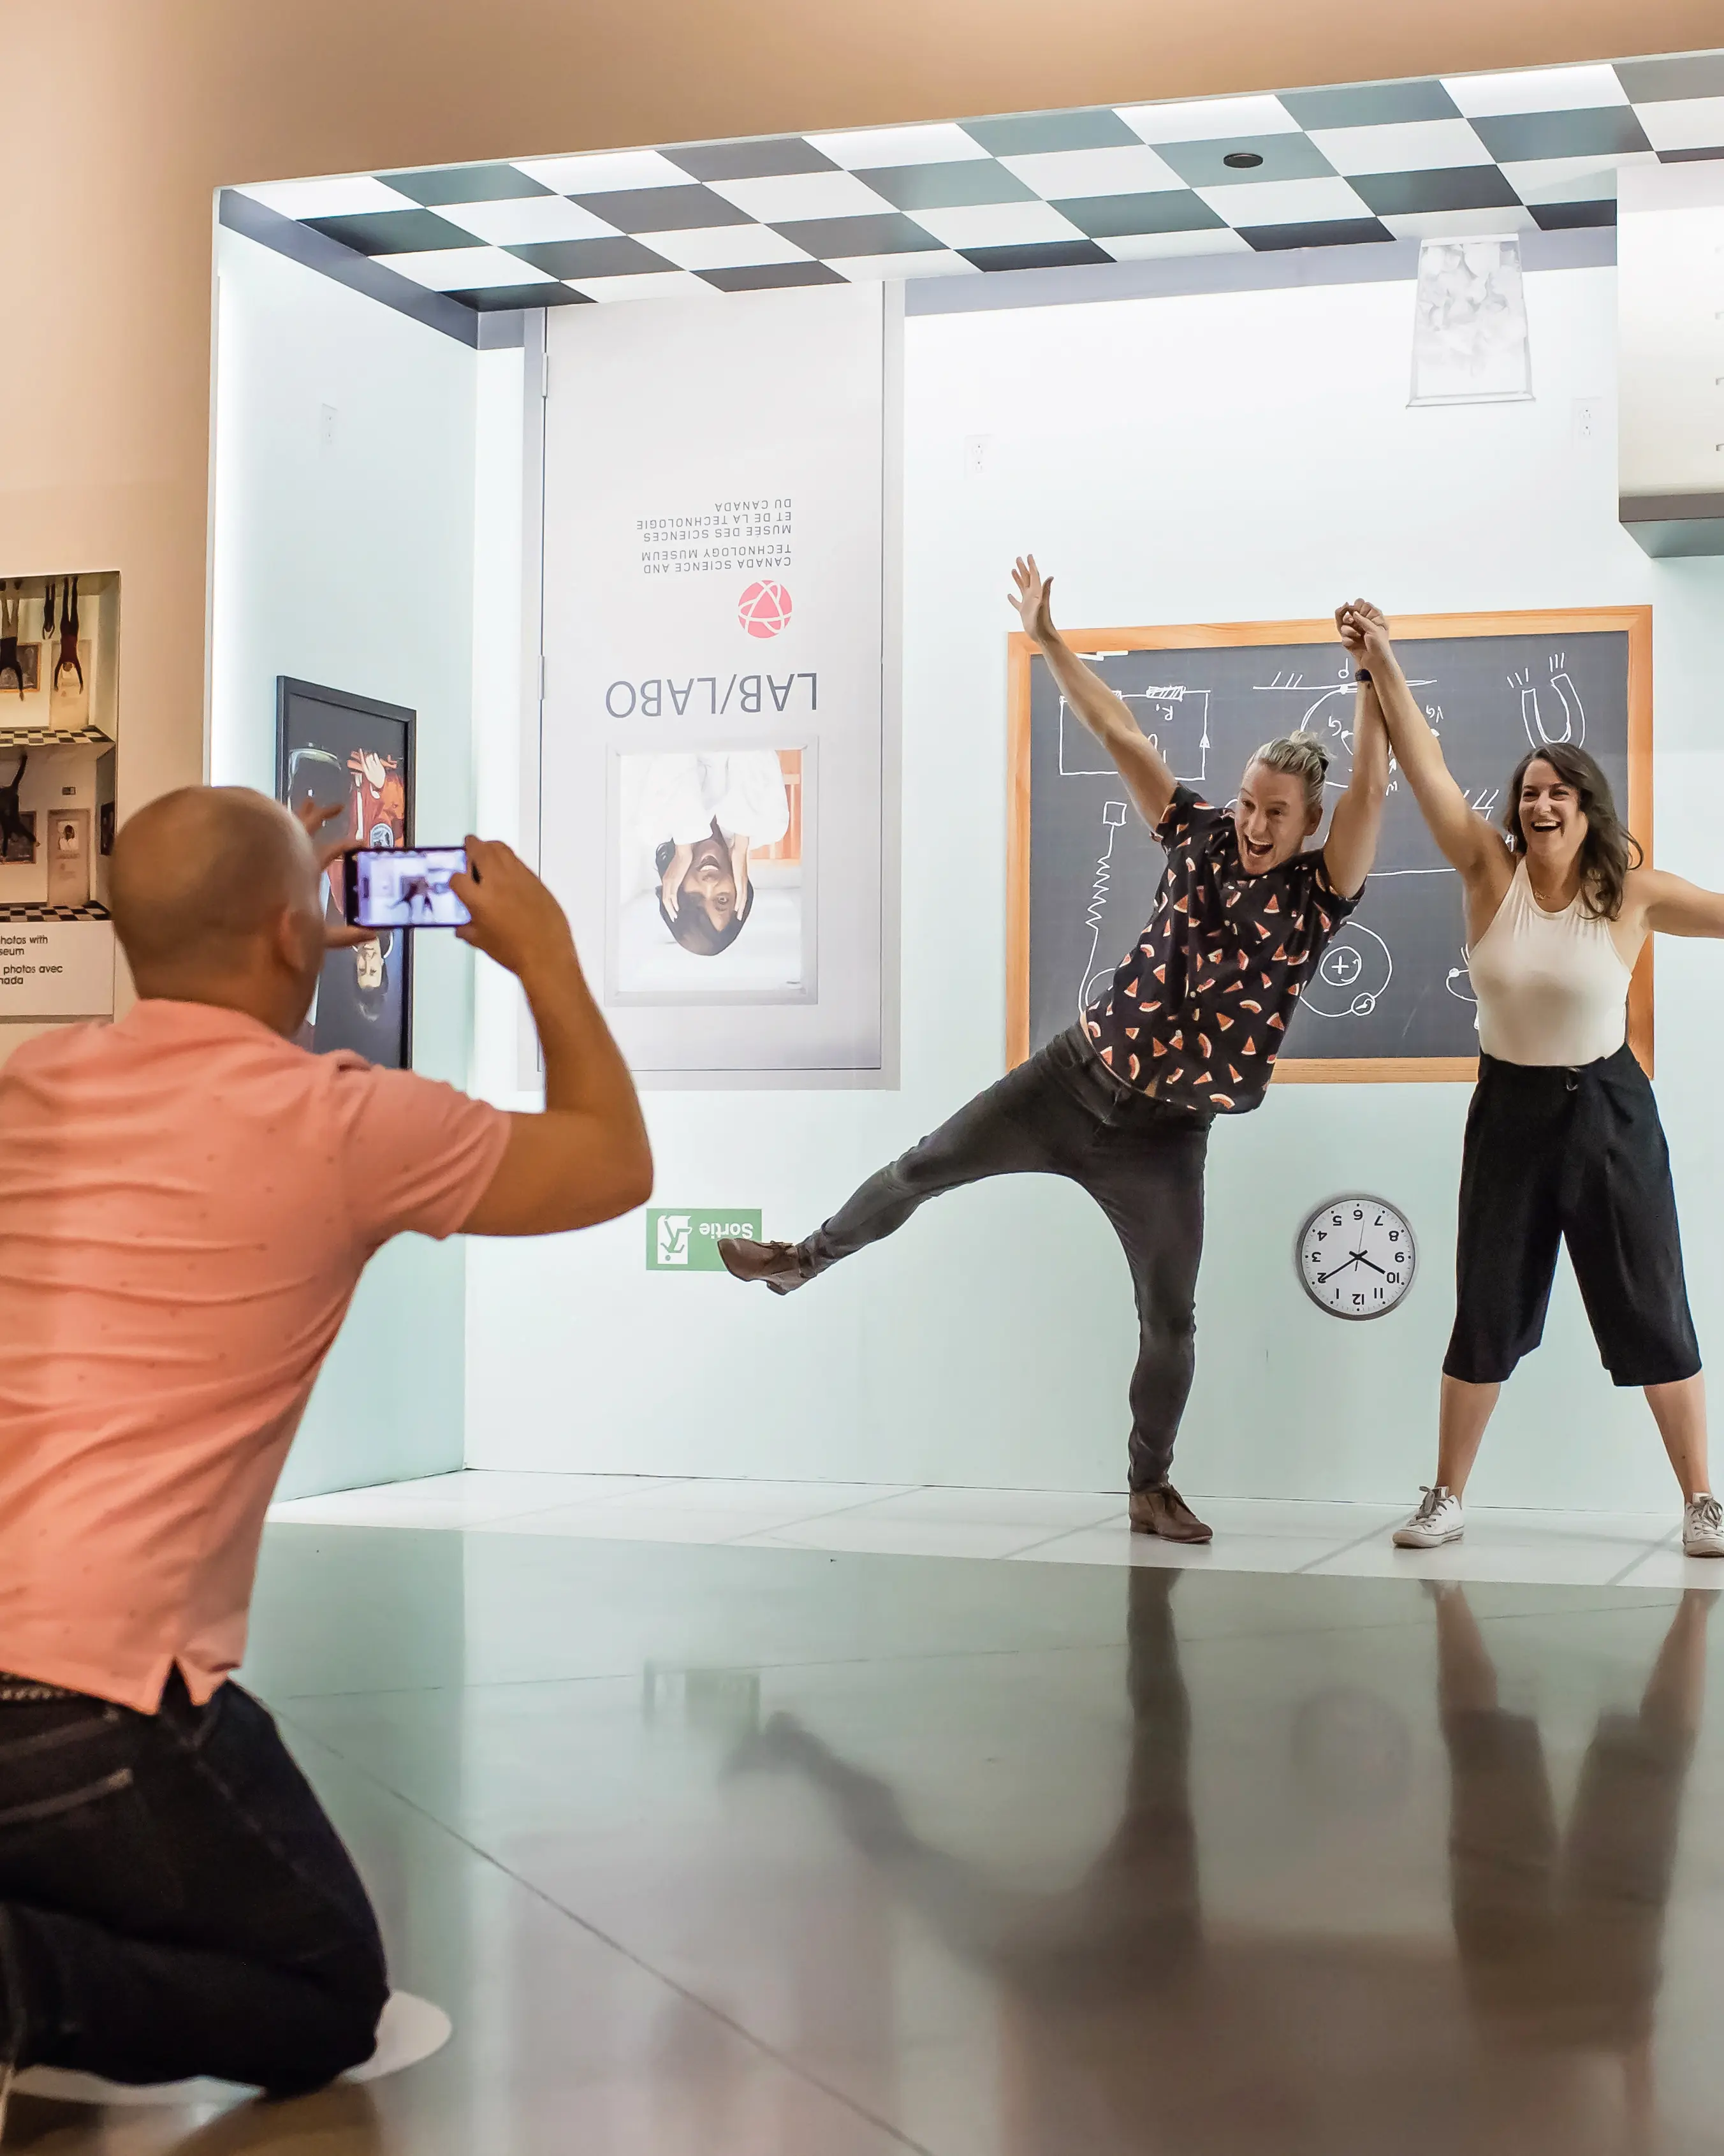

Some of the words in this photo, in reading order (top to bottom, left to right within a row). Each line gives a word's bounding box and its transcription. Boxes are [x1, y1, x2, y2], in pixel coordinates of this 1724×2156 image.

[715, 501, 768, 511] CANADA
[775, 499, 791, 508] DU
[733, 515, 748, 524] LA
[755, 513, 770, 522] DE
[777, 512, 791, 521] ET
[637, 516, 728, 529] TECHNOLOGIE
[643, 530, 708, 541] SCIENCES
[715, 528, 740, 538] DES
[747, 525, 791, 537] MUSÉE
[642, 550, 697, 561] MUSEUM
[704, 545, 791, 558] TECHNOLOGY
[675, 561, 731, 572] SCIENCE
[738, 557, 791, 568] CANADA
[644, 564, 669, 573] AND
[606, 673, 817, 718] LAB/LABO
[3, 964, 36, 975] photos
[1333, 1215, 1341, 1226] 5
[1354, 1210, 1362, 1220] 6
[1375, 1215, 1383, 1226] 7
[699, 1222, 753, 1238] Sortie
[1317, 1231, 1327, 1241] 4
[1389, 1231, 1399, 1242] 8
[1311, 1252, 1321, 1262] 3
[1395, 1252, 1404, 1263] 9
[1317, 1273, 1327, 1284] 2
[1387, 1272, 1399, 1284] 10
[1374, 1287, 1383, 1299] 11
[1352, 1294, 1364, 1305] 12
